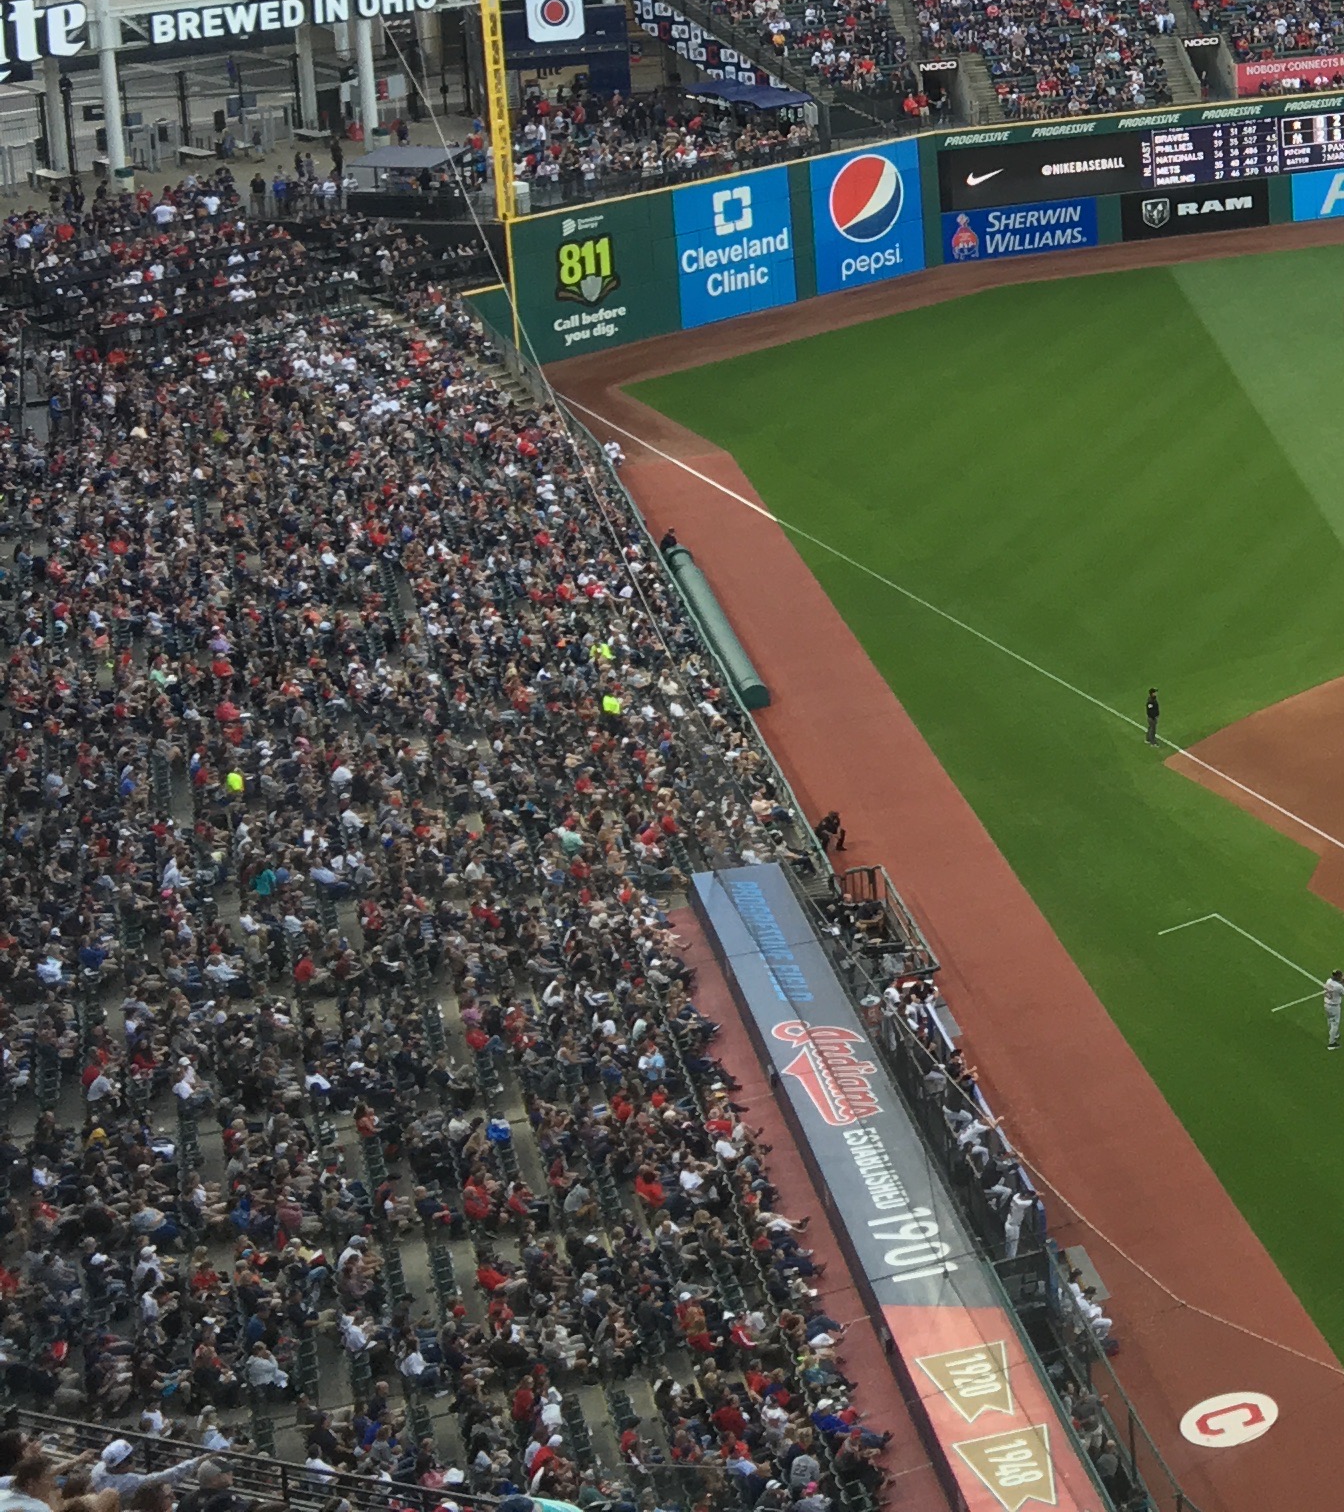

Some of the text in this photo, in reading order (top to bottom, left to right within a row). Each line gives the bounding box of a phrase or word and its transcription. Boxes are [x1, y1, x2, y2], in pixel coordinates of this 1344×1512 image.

[1184, 36, 1220, 49] NOCO
[918, 59, 958, 72] NOCO
[1246, 62, 1287, 76] NOBODY
[1288, 57, 1344, 71] CONNECTS
[1201, 105, 1263, 120] PROGRESSIVE
[1284, 96, 1344, 111] PROGRESSIVE
[1031, 122, 1096, 138] PROGRESSIVE
[1117, 113, 1181, 129] PROGRESSIVE
[944, 131, 1011, 147] PROGRESSIVE
[1041, 157, 1125, 176] @NIKEBASEBALL
[1156, 152, 1204, 164] NATIONALS
[1177, 196, 1253, 216] RAM
[986, 206, 1081, 233] SHERWIN
[681, 227, 789, 274] Cleveland
[985, 227, 1087, 255] WILLIAMS.
[559, 237, 612, 285] 811
[841, 243, 903, 281] pepsi
[706, 263, 770, 297] Clinic
[553, 306, 626, 332] Call before
[564, 322, 619, 347] you dig.
[771, 1020, 884, 1126] Indians
[842, 1128, 959, 1283] ESTABLISHED 1901
[944, 1352, 1001, 1398] 1920
[984, 1440, 1043, 1489] 1948
